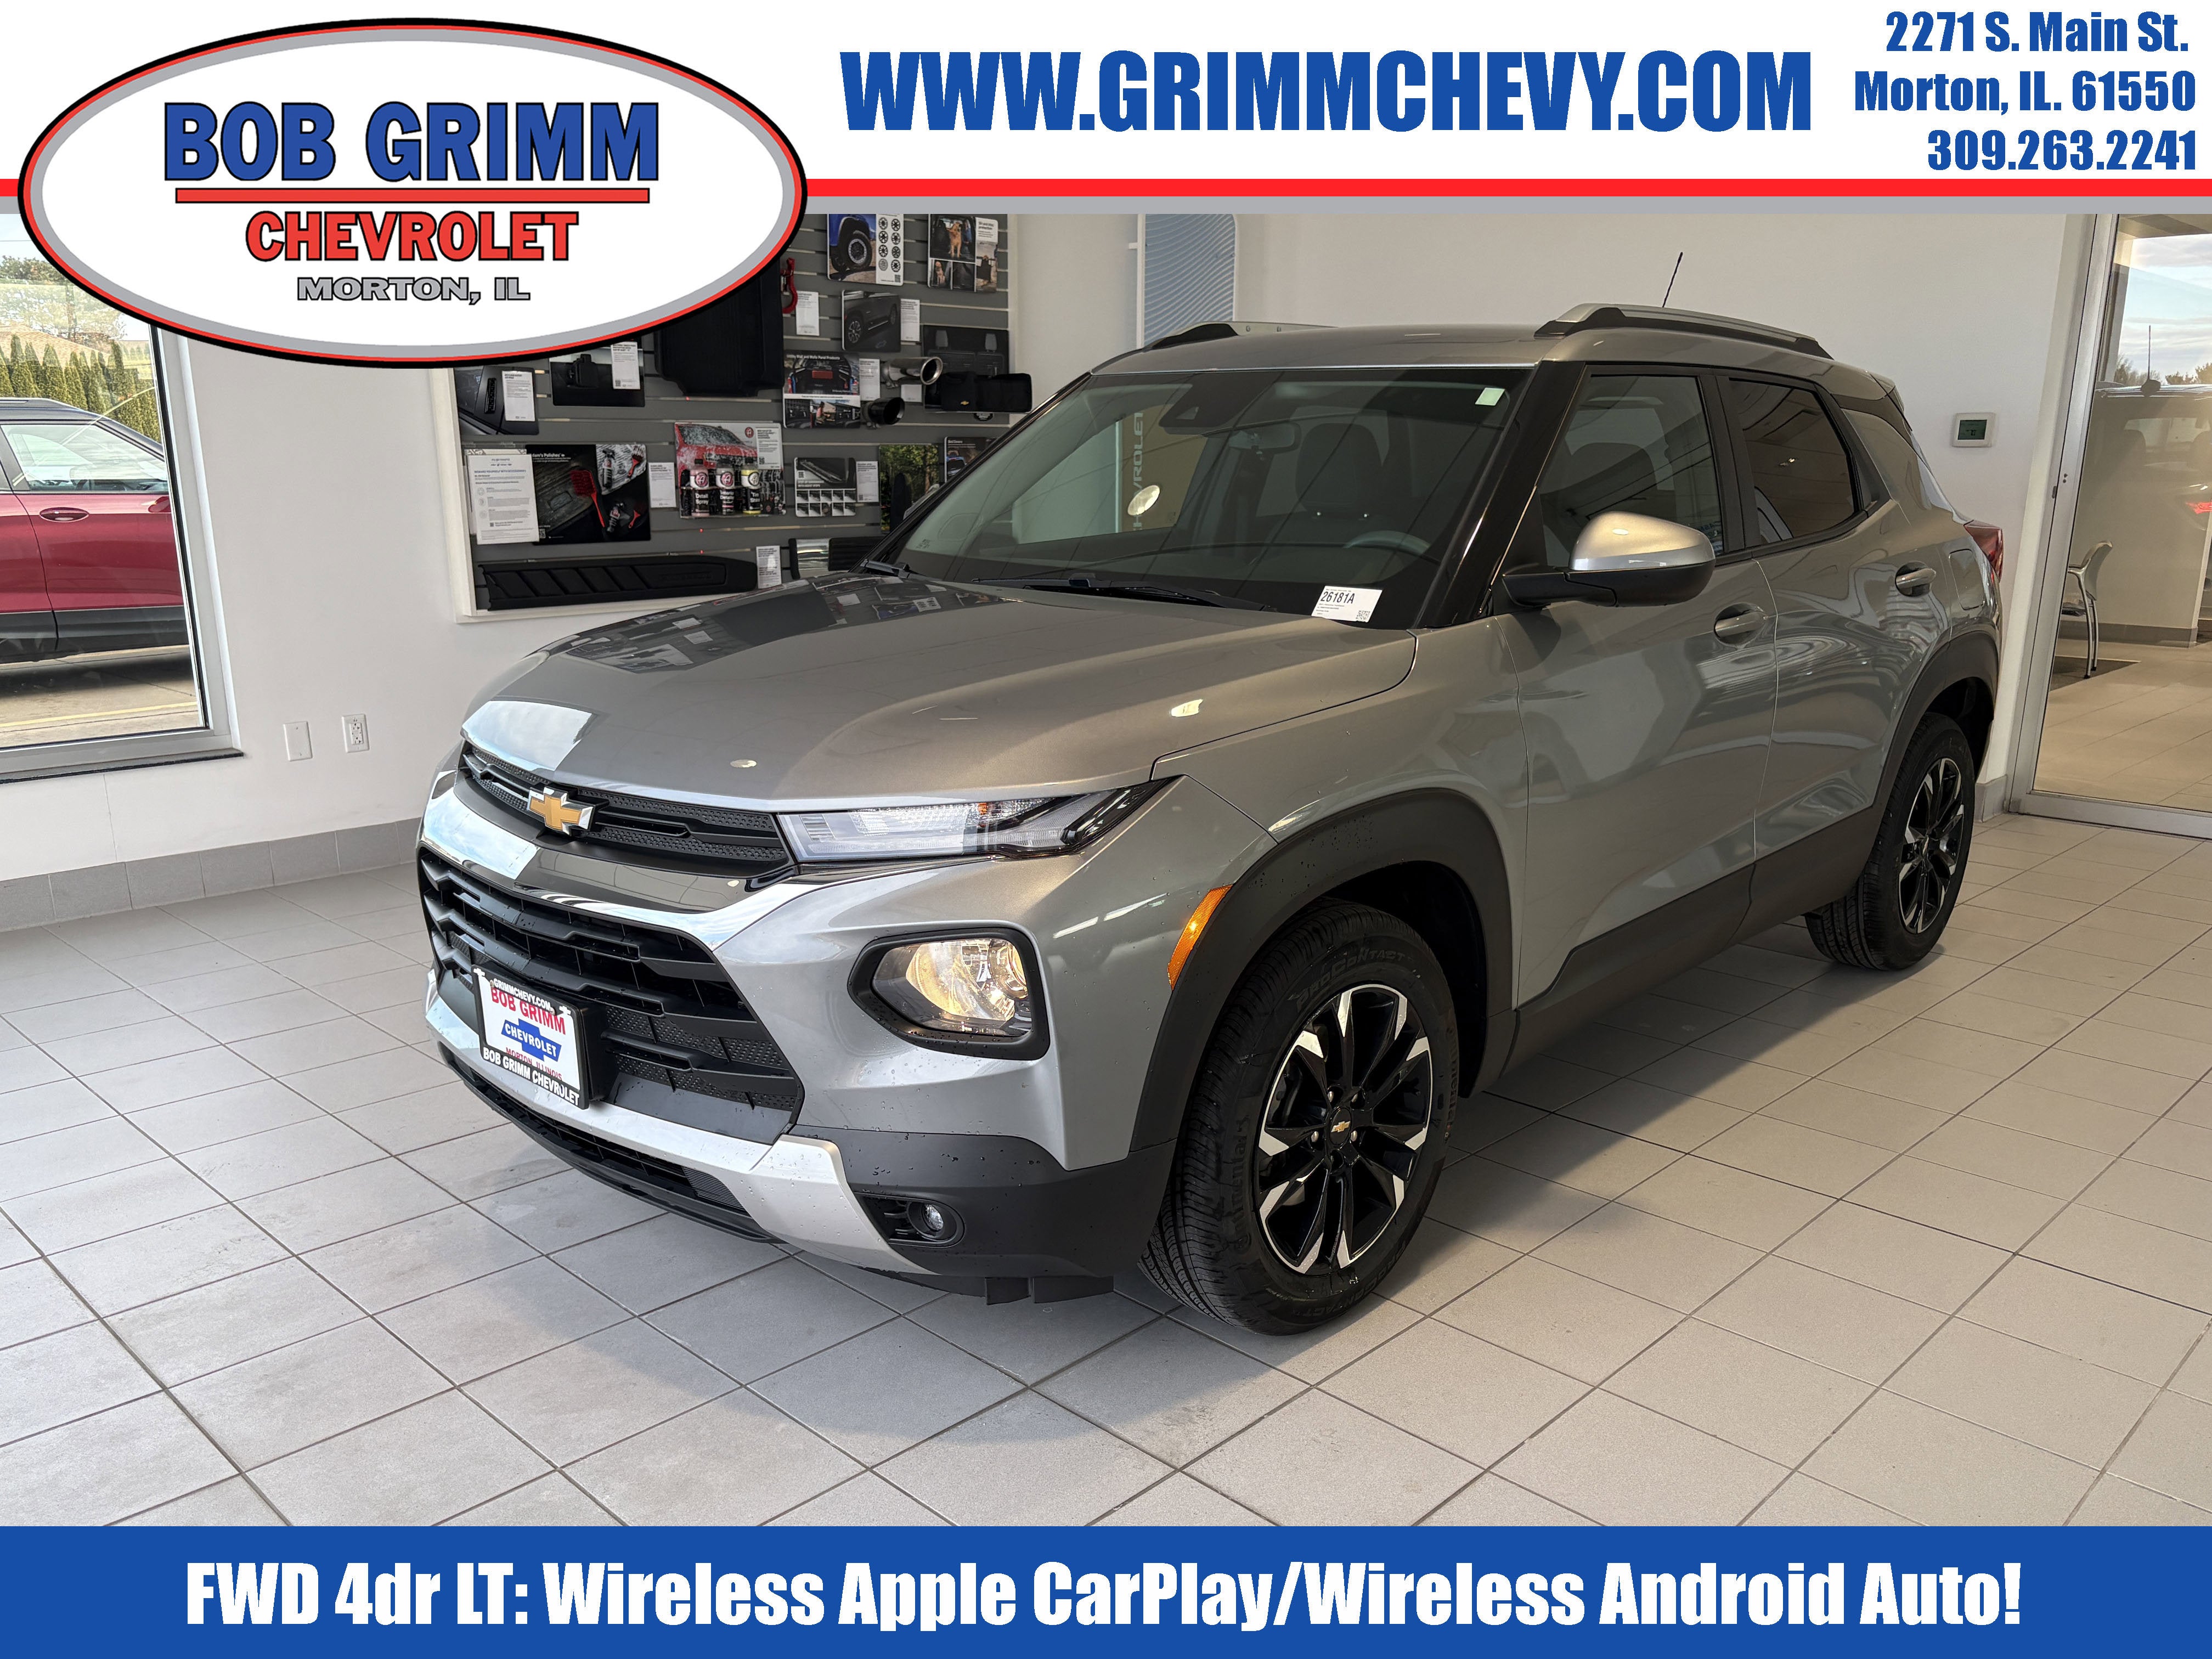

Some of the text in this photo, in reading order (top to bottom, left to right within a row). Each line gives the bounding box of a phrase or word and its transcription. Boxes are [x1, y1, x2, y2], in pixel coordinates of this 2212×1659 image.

[1320, 591, 1355, 604] 26181A
[491, 987, 566, 1035] BOB GRIMM
[505, 1023, 557, 1058] CHEVROLET
[483, 1047, 580, 1106] BOB GRIMM CHEVROLET
[506, 1047, 563, 1080] MORTON ILLINOIS
